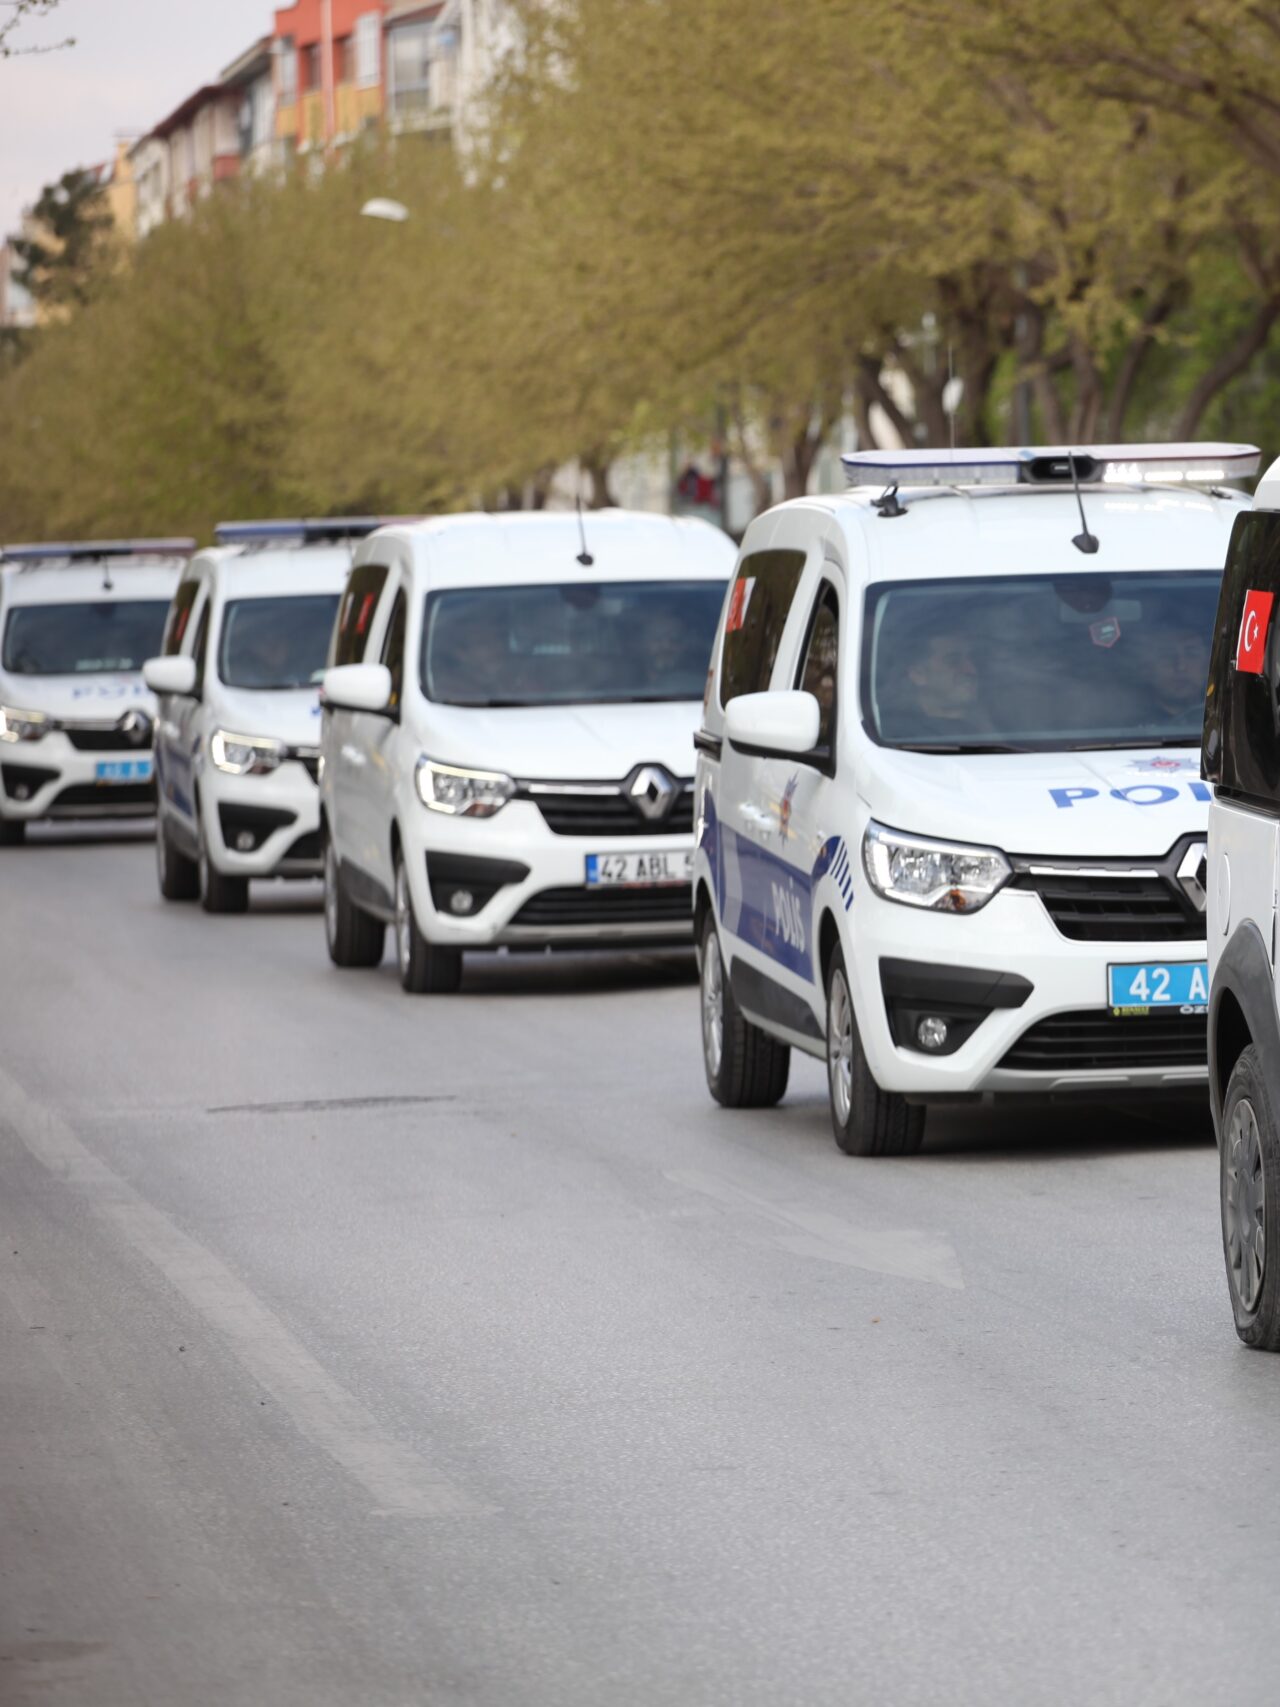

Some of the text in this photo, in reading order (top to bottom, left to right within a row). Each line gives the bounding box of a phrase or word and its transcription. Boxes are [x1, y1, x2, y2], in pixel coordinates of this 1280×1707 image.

[601, 858, 628, 878] 42
[1129, 966, 1207, 1001] 42 A
